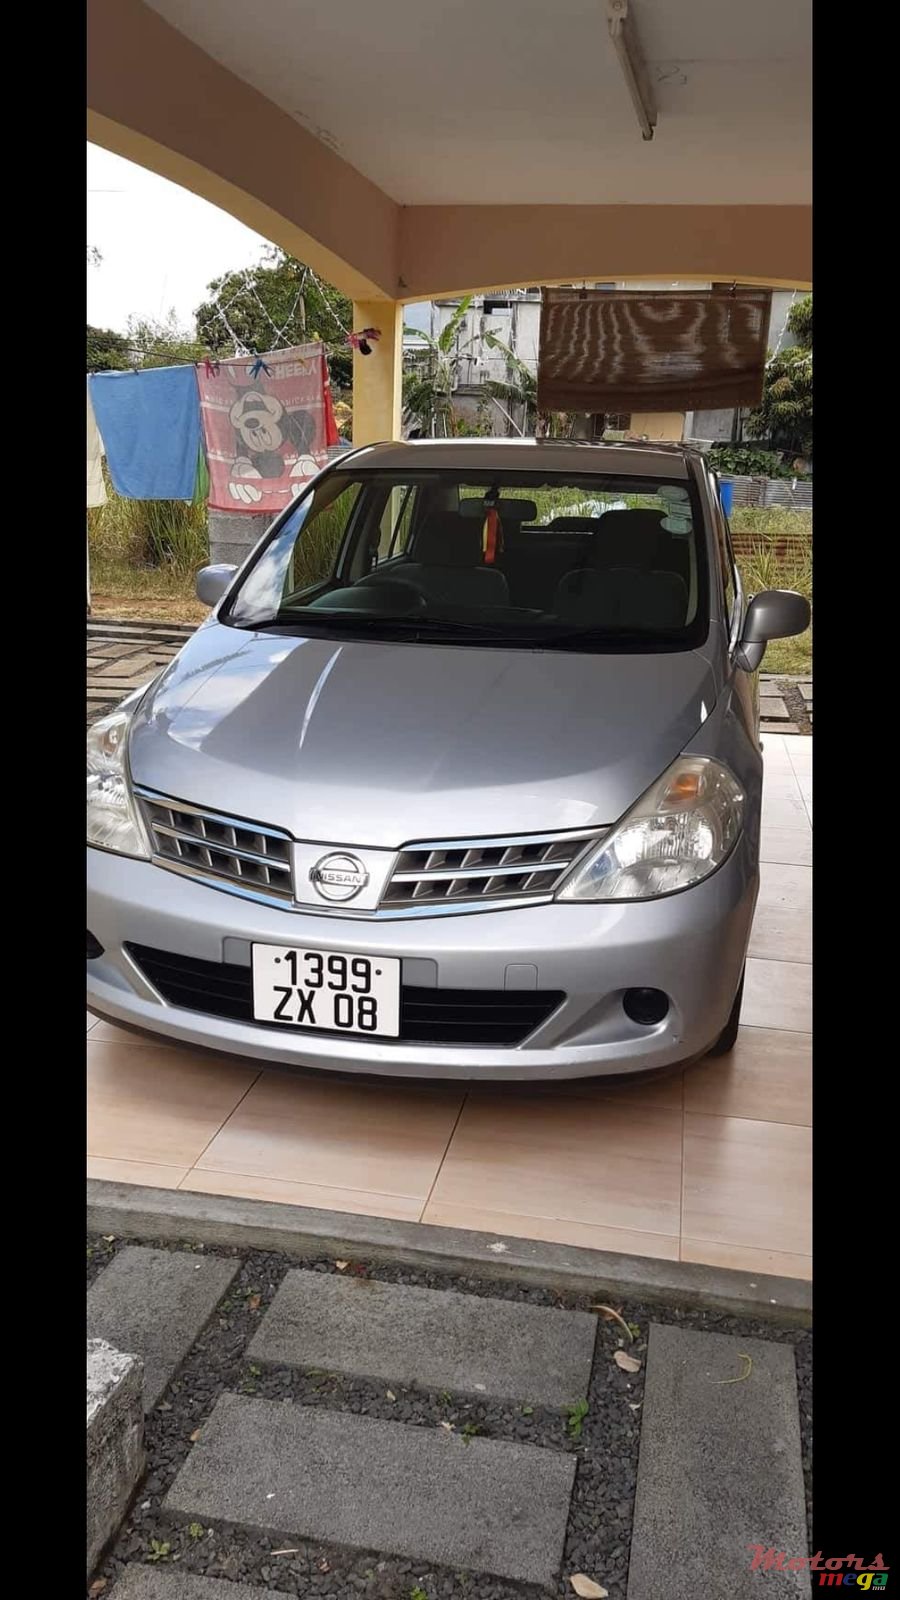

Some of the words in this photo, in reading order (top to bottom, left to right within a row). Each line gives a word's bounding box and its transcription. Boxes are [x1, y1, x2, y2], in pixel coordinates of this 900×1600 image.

[318, 872, 362, 883] NISSAN
[284, 950, 371, 993] 1399
[273, 985, 316, 1024] ZX
[333, 993, 377, 1031] 08
